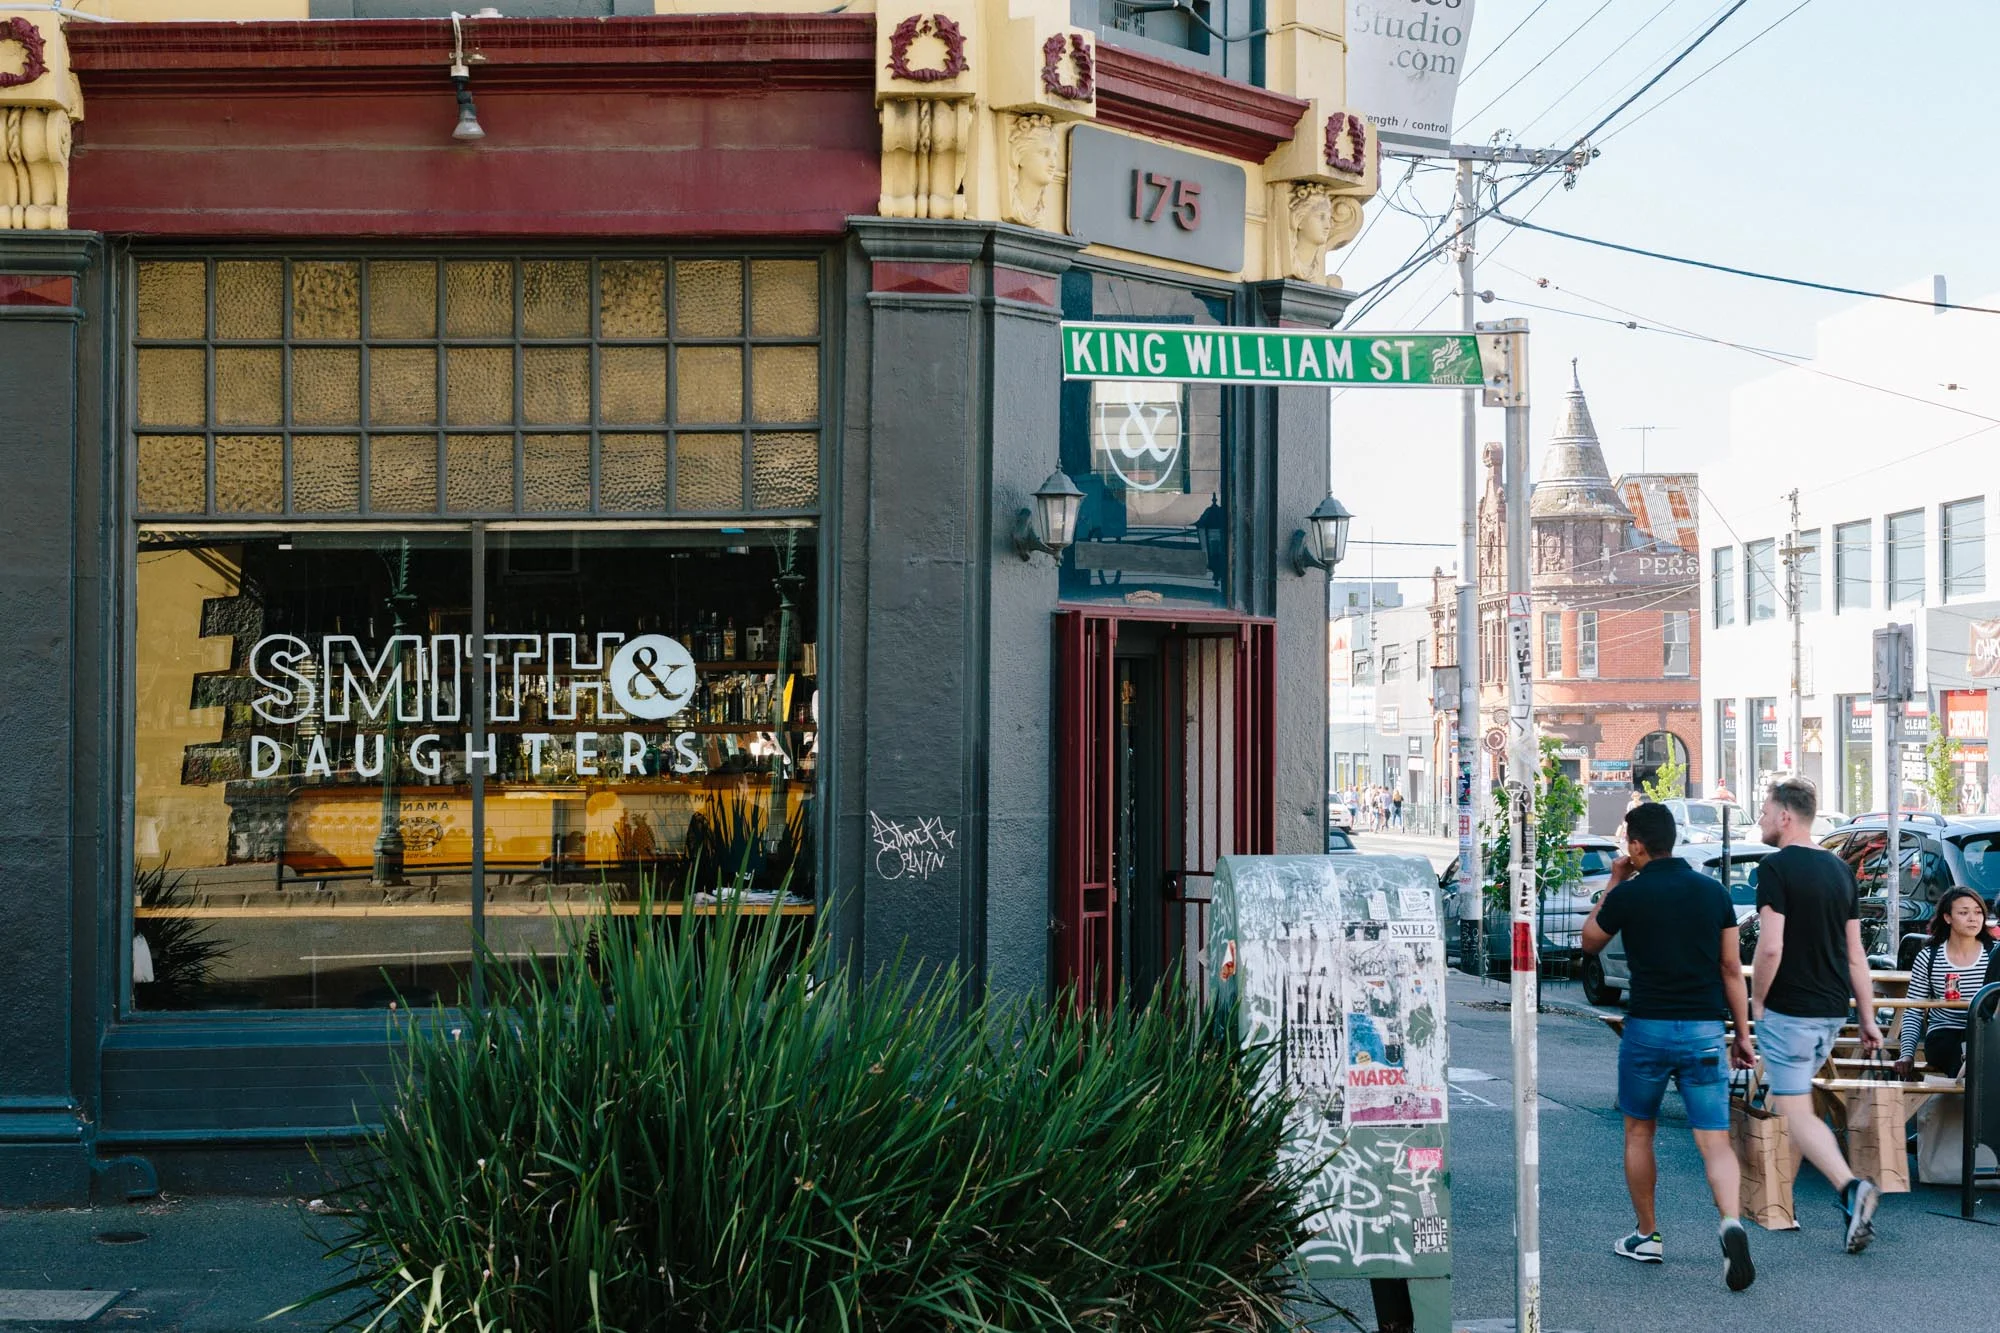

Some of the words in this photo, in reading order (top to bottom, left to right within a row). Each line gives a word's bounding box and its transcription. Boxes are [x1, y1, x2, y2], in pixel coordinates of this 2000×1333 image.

[1354, 3, 1462, 47] Studio
[1389, 49, 1456, 75] .com
[1366, 114, 1399, 131] ength
[1412, 121, 1449, 134] control
[1131, 169, 1202, 231] 175
[1071, 331, 1167, 374] KING
[1183, 334, 1354, 380] WILLIAM
[1370, 340, 1415, 381] ST
[250, 632, 625, 724] SMITH
[250, 731, 699, 778] DAUGHTERS
[1391, 924, 1436, 936] SWEL2
[1412, 1216, 1448, 1233] DWANE
